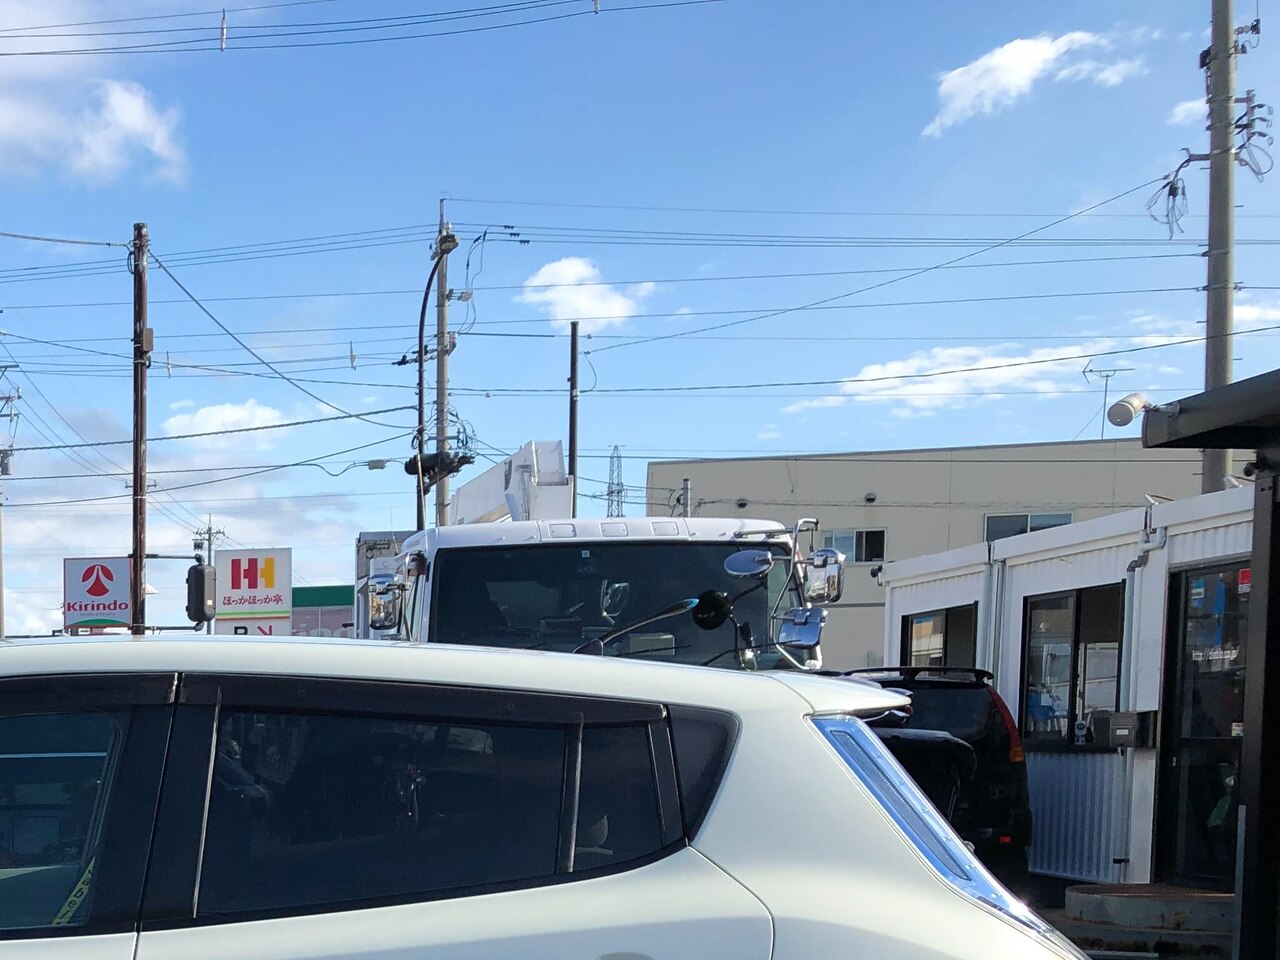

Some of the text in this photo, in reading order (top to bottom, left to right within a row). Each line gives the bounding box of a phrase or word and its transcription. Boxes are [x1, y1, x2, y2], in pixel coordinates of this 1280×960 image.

[67, 600, 129, 612] Kirindo
[223, 594, 283, 606] ほっかほっか亭
